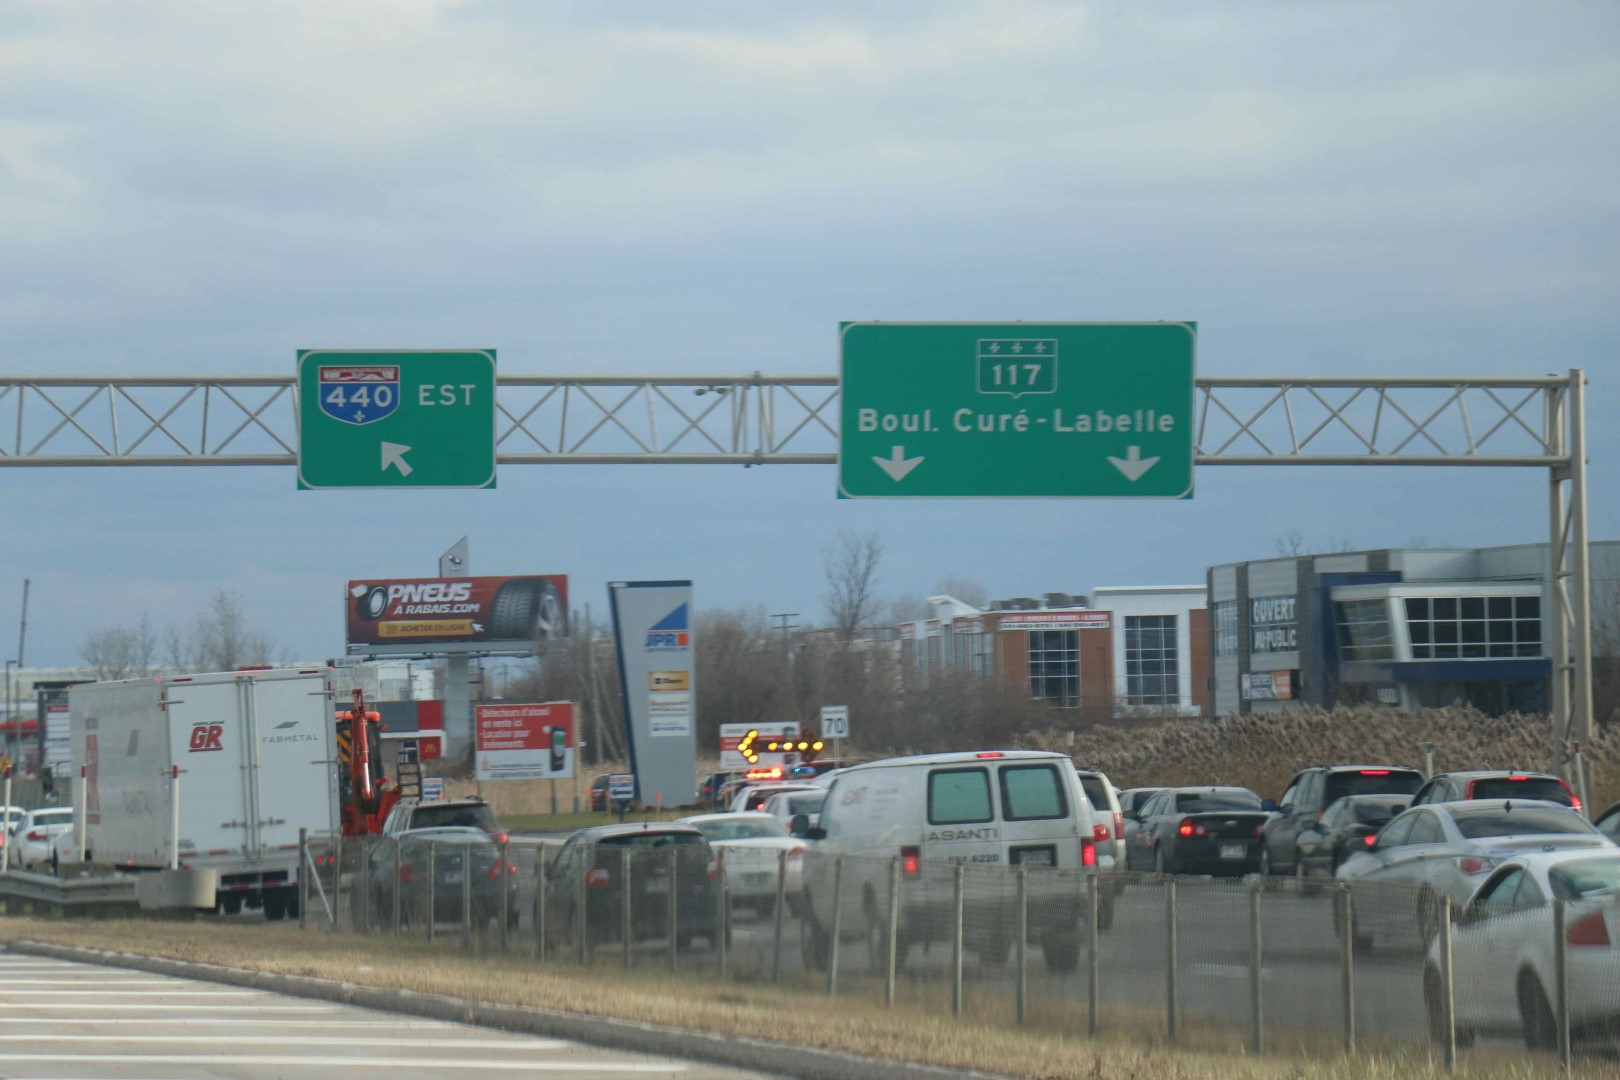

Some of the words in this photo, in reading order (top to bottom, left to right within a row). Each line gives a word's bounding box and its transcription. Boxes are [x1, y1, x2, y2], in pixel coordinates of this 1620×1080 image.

[991, 364, 1042, 385] 117
[326, 386, 392, 408] 440
[419, 384, 476, 406] EST
[857, 408, 939, 432] Boul.
[387, 582, 472, 605] PNEUS
[405, 603, 480, 614] RABAIS.COM
[401, 624, 432, 632] ACHETER
[824, 717, 847, 734] 70
[190, 725, 223, 748] GR
[929, 828, 999, 841] ASANTI
